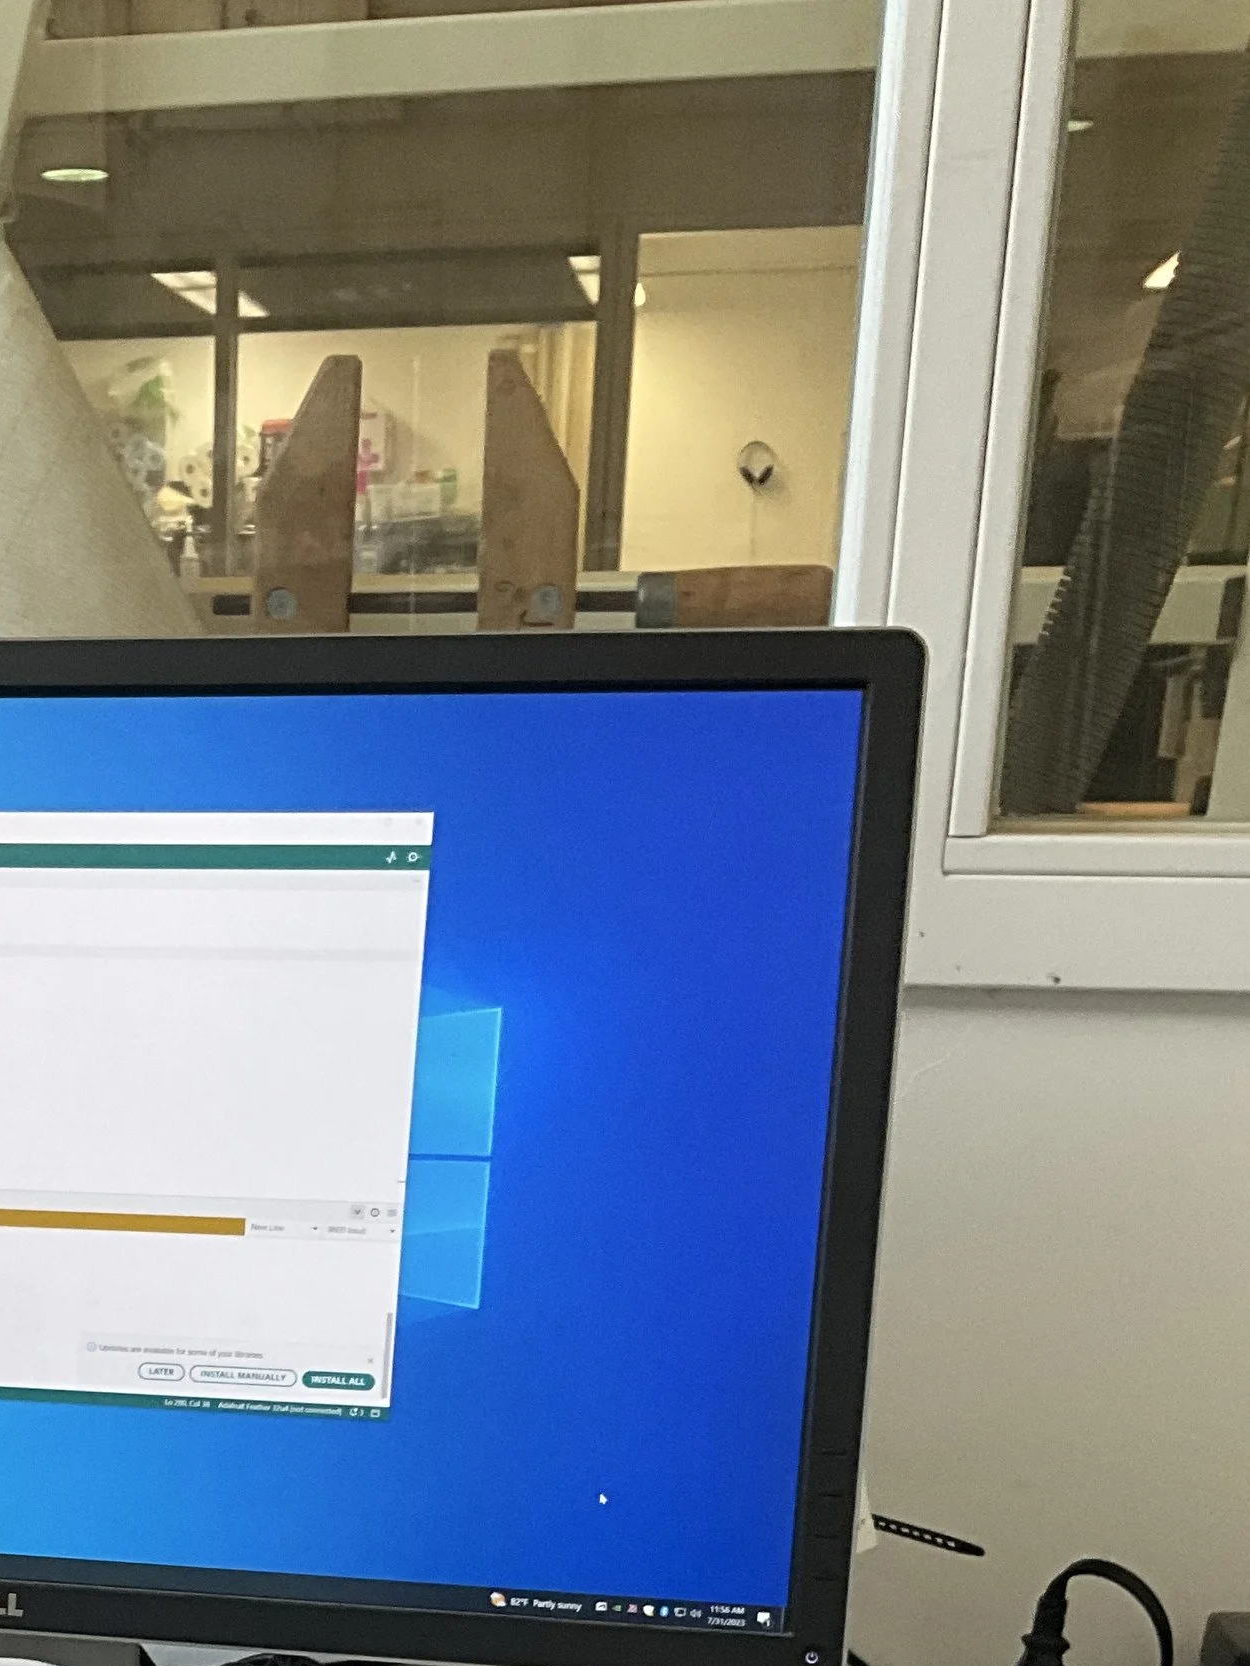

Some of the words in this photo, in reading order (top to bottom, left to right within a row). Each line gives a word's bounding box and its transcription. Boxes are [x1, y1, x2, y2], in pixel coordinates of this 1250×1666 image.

[148, 1367, 175, 1376] LATER
[200, 1370, 236, 1380] INSTALL
[237, 1372, 287, 1382] MANUALLY
[310, 1375, 347, 1386] INSTALL
[348, 1377, 366, 1387] ALL
[533, 1598, 557, 1612] Partly
[557, 1602, 583, 1613] sunny
[731, 1606, 746, 1615] AM
[707, 1616, 747, 1627] 7/31/2023
